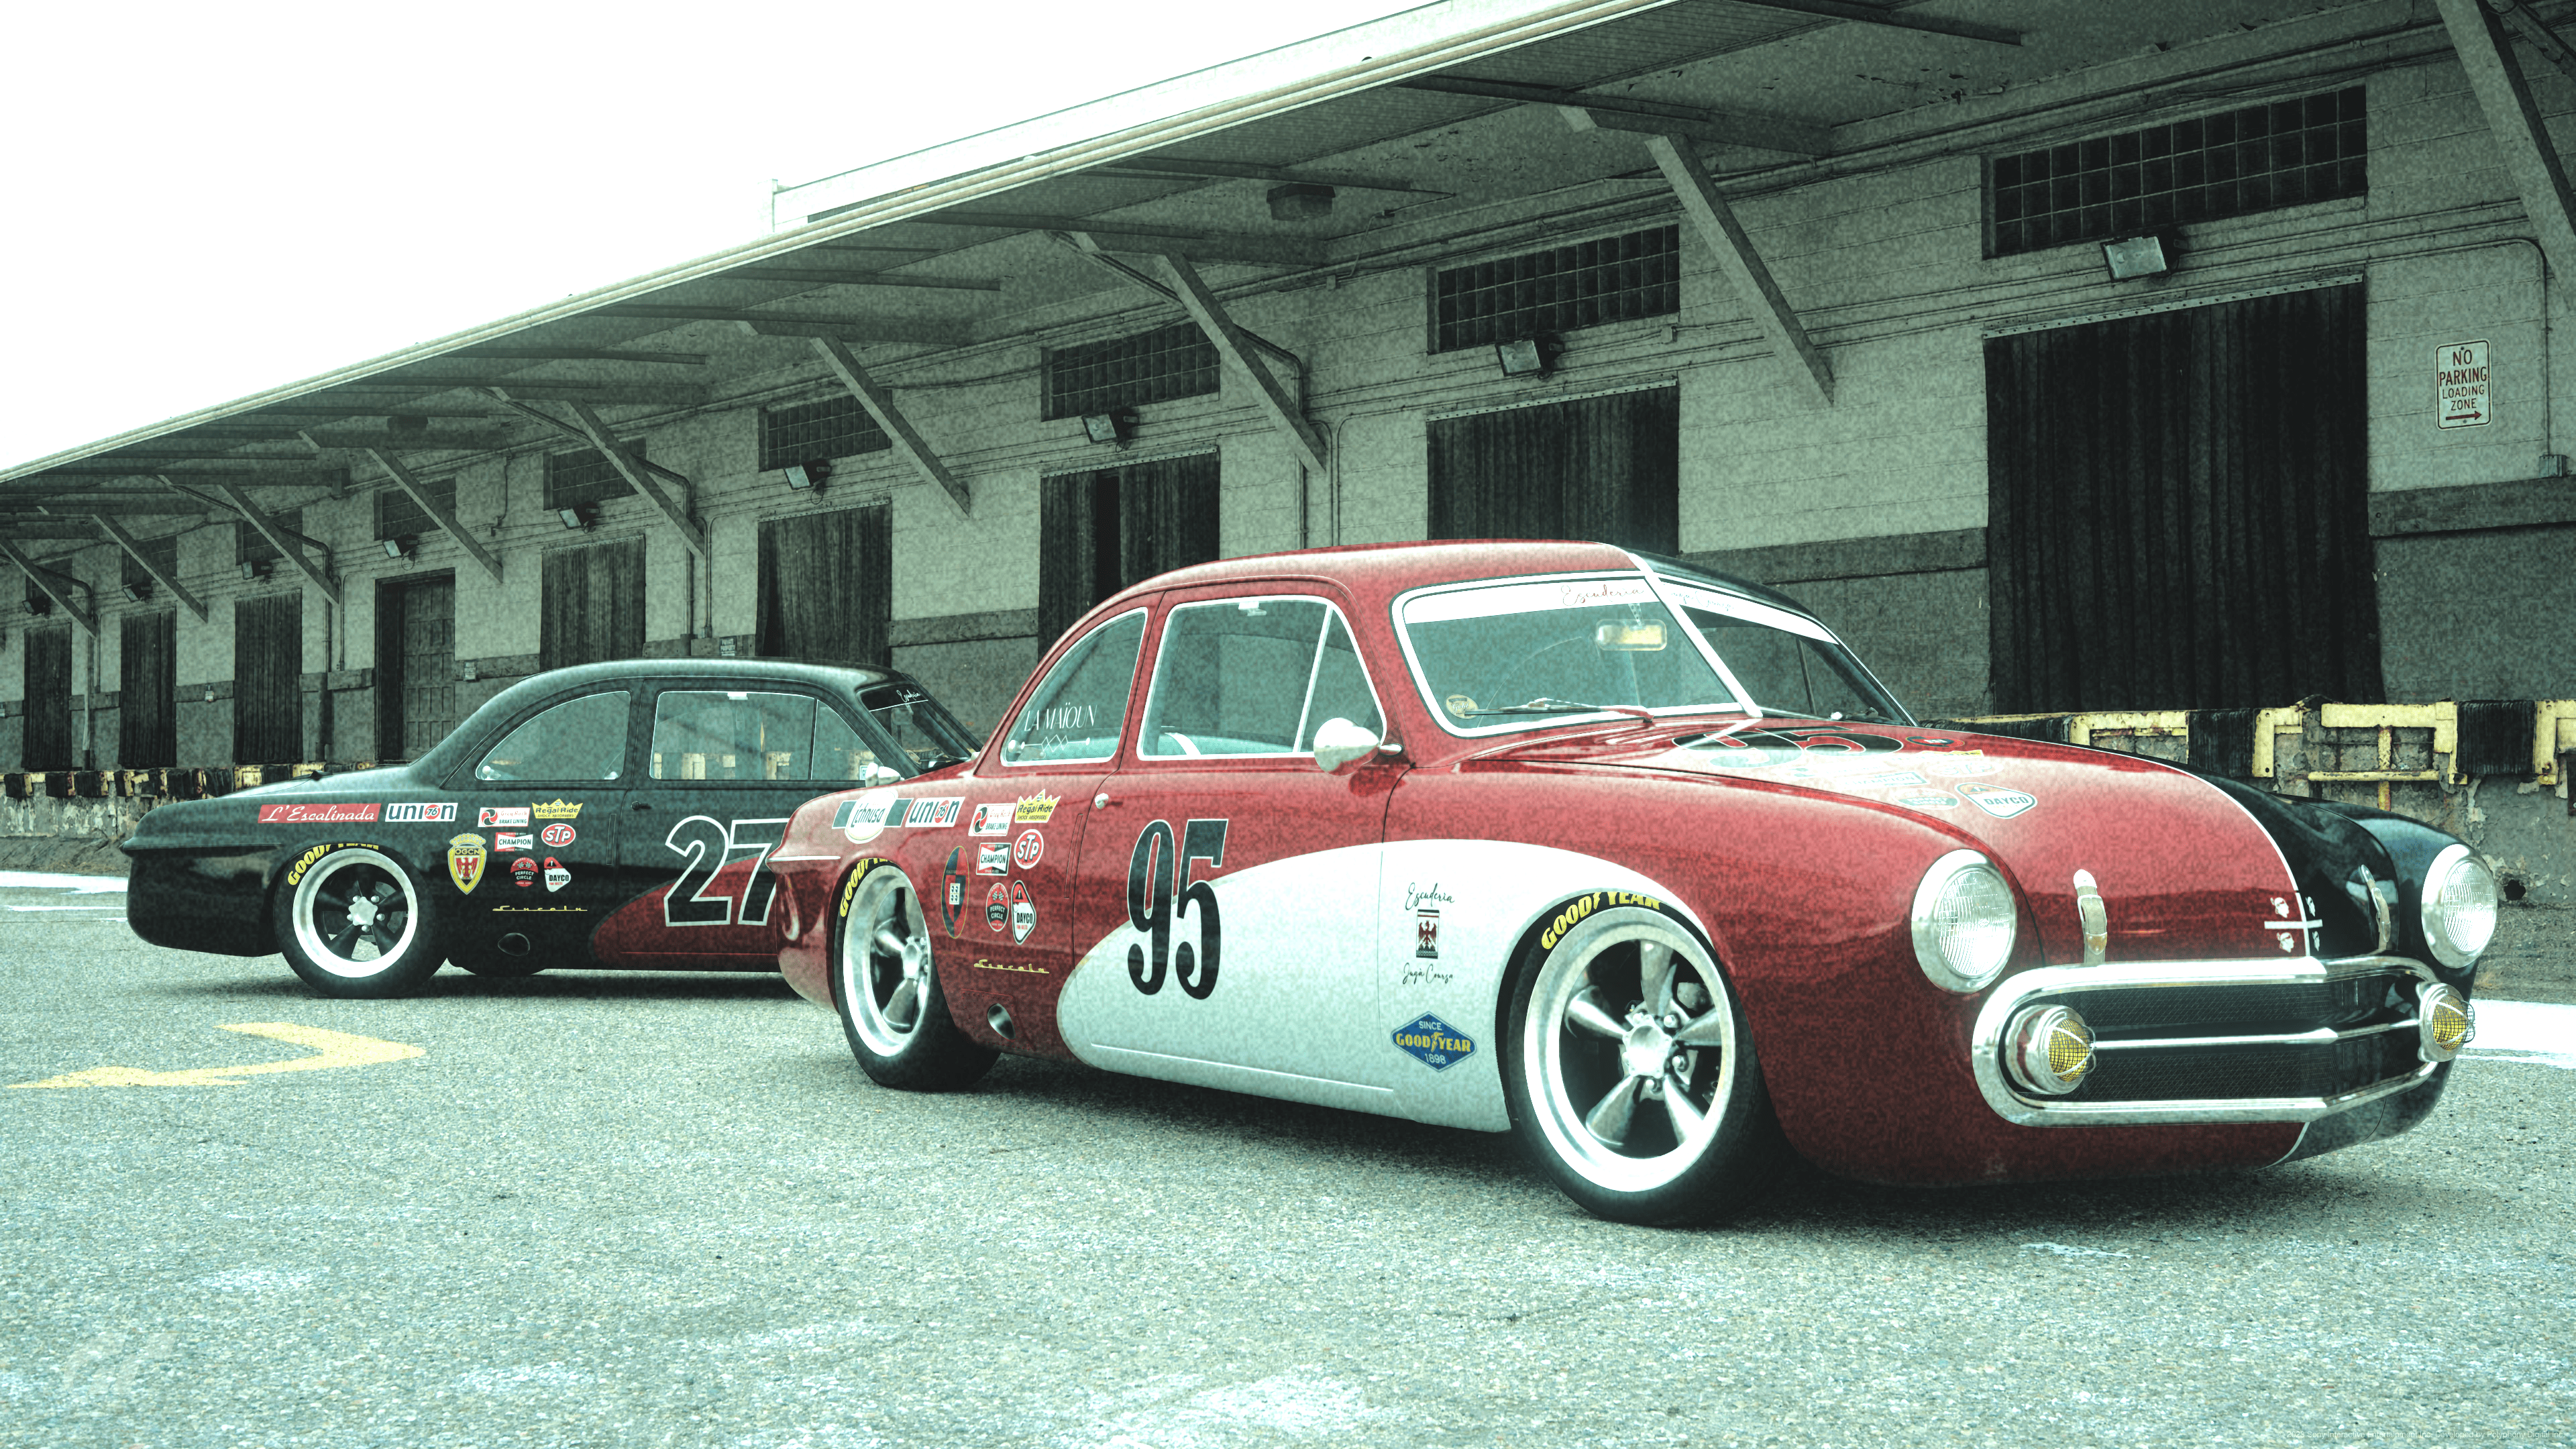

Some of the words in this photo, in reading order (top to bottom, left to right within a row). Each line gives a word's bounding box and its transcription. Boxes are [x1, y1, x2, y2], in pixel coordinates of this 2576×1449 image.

[2453, 350, 2473, 366] NO
[2439, 366, 2487, 386] PARKING
[2443, 384, 2485, 399] LOADING
[2451, 398, 2477, 411] ZONE
[1024, 710, 1040, 732] LA
[1671, 725, 1904, 768] 95
[1984, 796, 2029, 805] DAYCO
[262, 804, 375, 822] L'Escalinada
[425, 806, 439, 816] 76
[545, 826, 571, 843] STP
[1017, 834, 1040, 862] STP
[981, 854, 1006, 864] CHAMPION
[663, 815, 790, 926] 27
[989, 905, 1006, 913] PERFECT
[1127, 818, 1229, 1000] 95
[1017, 912, 1033, 924] DAYCO
[1419, 1020, 1442, 1031] SINCE
[1424, 1053, 1446, 1065] 1898
